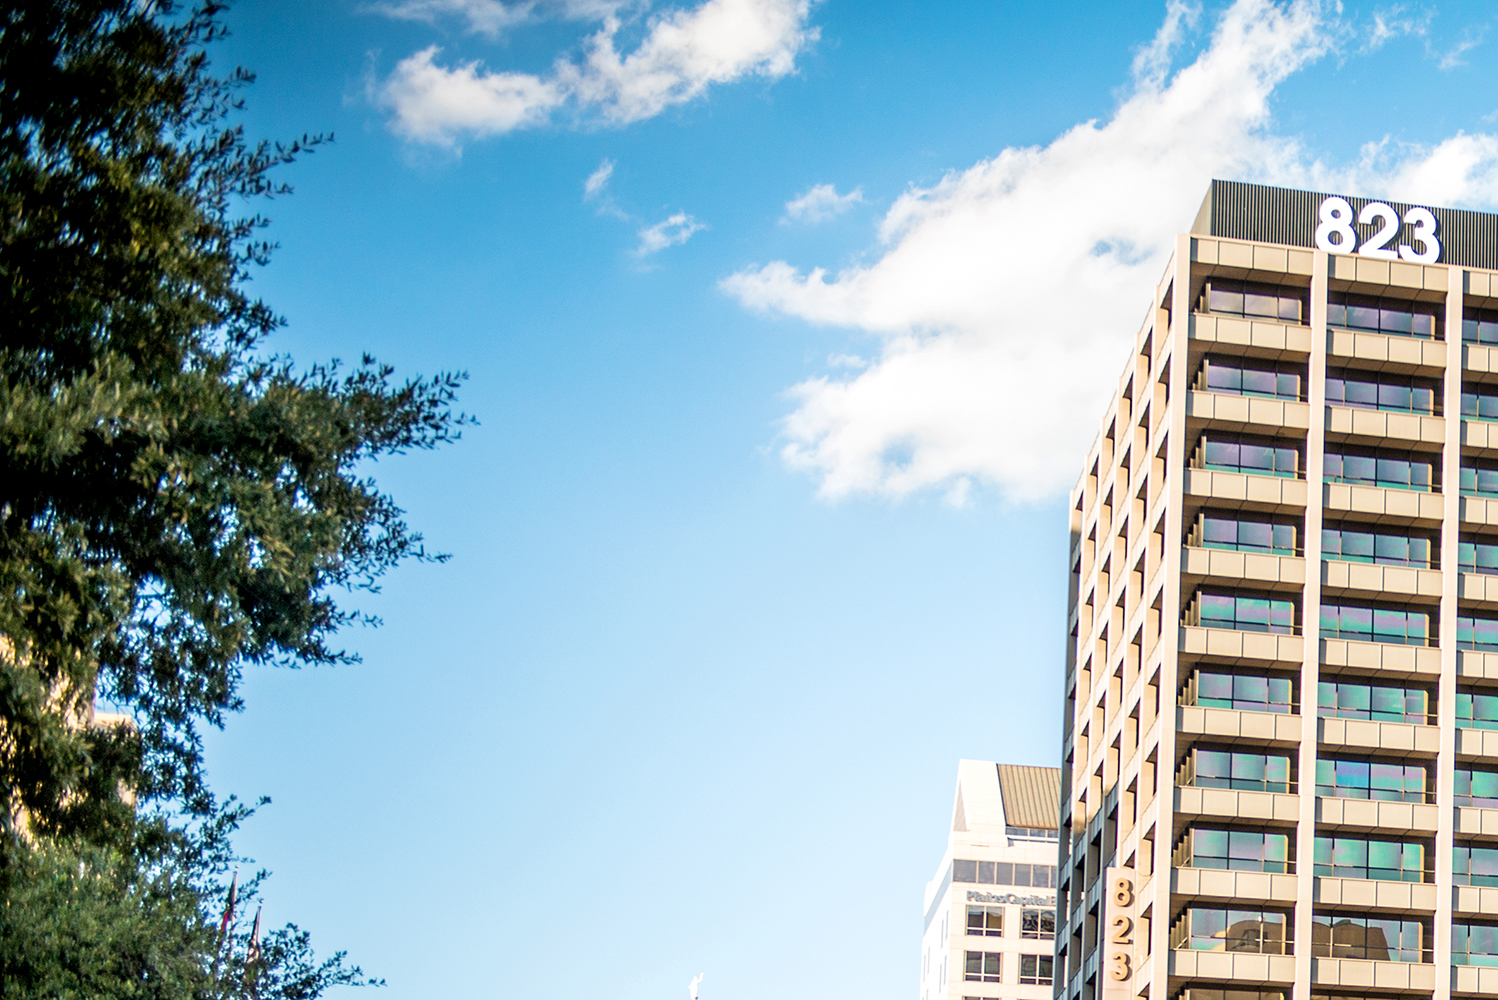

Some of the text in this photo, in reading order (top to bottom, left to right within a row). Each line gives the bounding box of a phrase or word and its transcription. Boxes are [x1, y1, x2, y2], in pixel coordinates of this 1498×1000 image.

[1315, 196, 1441, 265] 823
[966, 890, 1049, 907] PlainsCapital
[1110, 877, 1134, 982] 823
